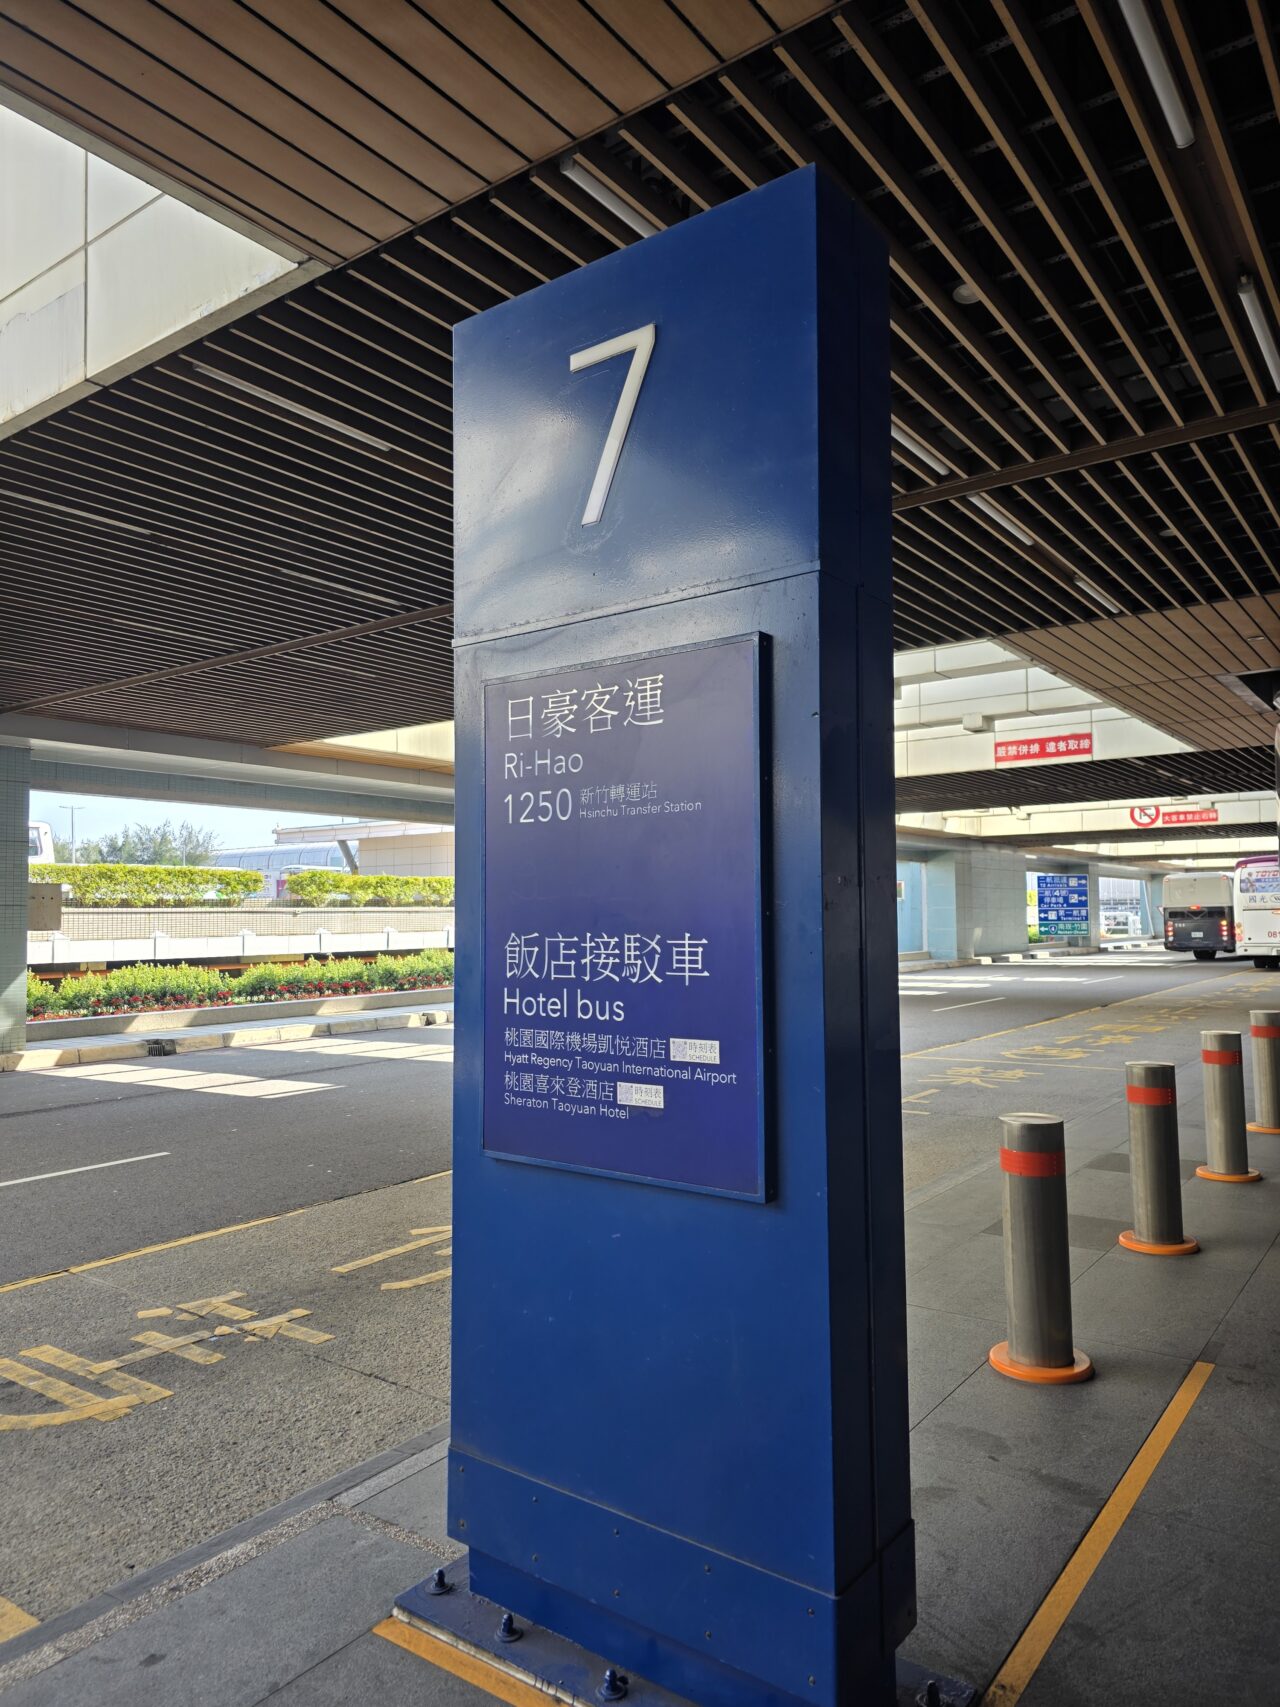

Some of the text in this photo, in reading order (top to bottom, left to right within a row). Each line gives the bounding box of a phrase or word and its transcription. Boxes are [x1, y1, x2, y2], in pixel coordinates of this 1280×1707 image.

[569, 322, 655, 527] 7
[507, 673, 665, 741] 日豪客運
[504, 748, 583, 779] Ri-Hao
[504, 788, 572, 824] 1250
[579, 782, 658, 805] 新竹轉運站
[579, 800, 702, 819] Hsinchu Transfer Station
[504, 931, 710, 986] 飯店接駁車
[503, 987, 625, 1022] Hotel bus
[504, 1050, 737, 1085] Hyatt Regency Taoyuan International Airport
[504, 1070, 614, 1101] 桃園喜來登酒店
[504, 1092, 629, 1120] Sheraton Taoyuan Hotel
